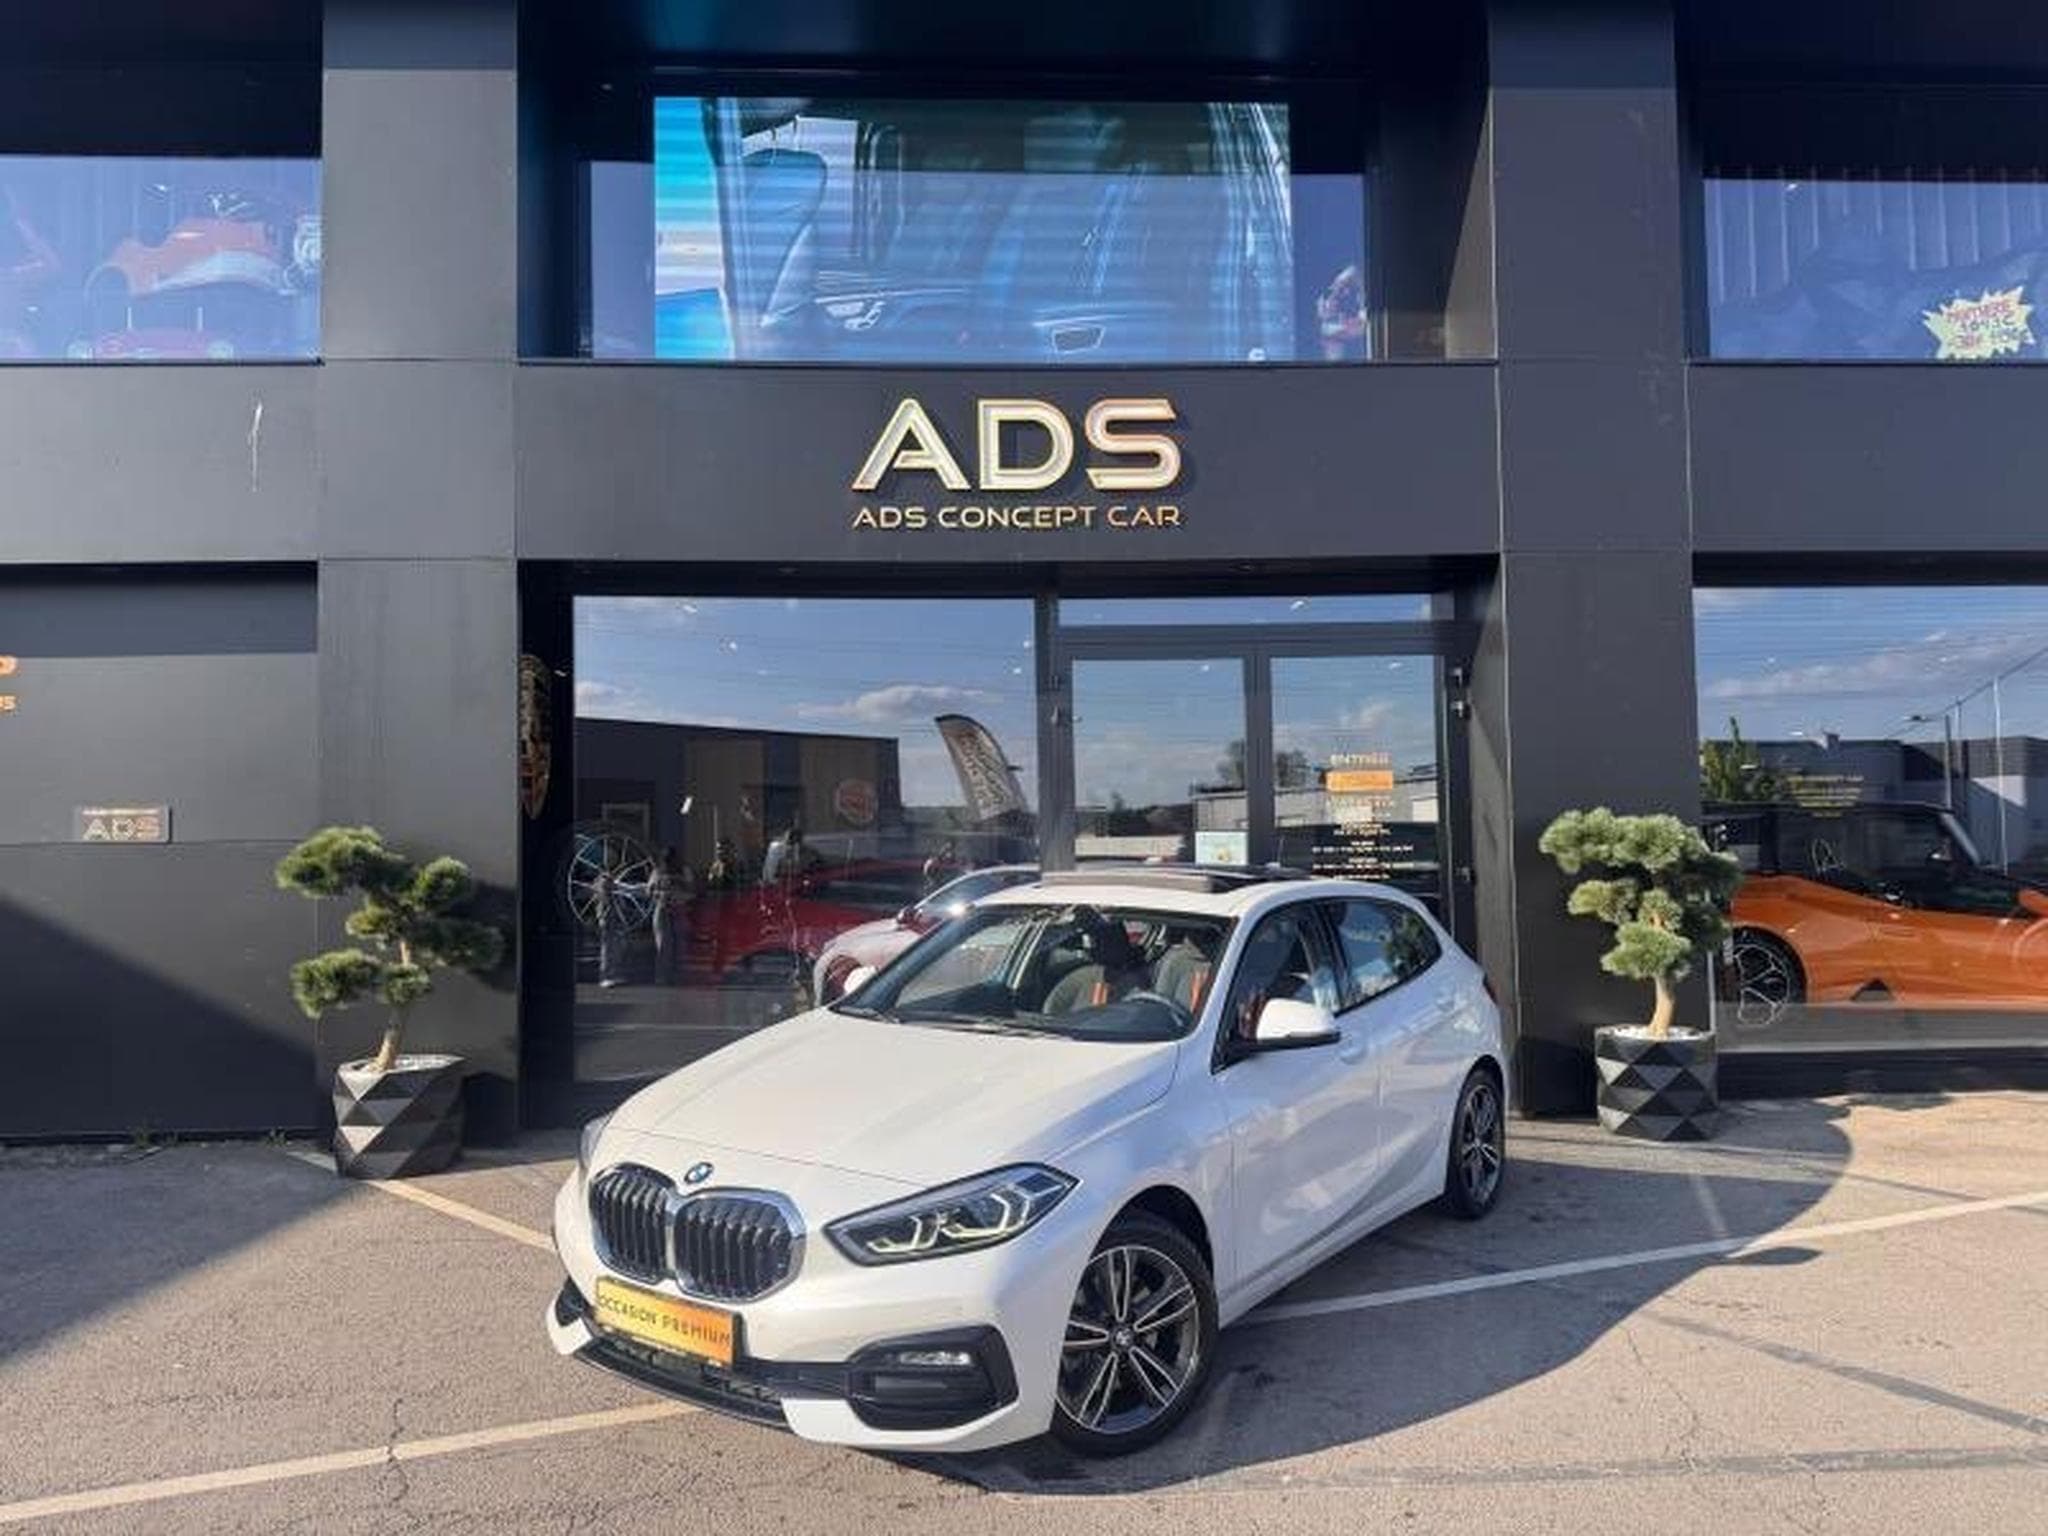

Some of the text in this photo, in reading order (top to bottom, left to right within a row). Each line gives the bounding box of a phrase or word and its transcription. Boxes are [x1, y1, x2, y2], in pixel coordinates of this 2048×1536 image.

[851, 398, 1181, 490] ADS
[852, 506, 1181, 528] ADS CONCEPT CAR
[599, 1294, 731, 1346] OCCASION PREMIUM
